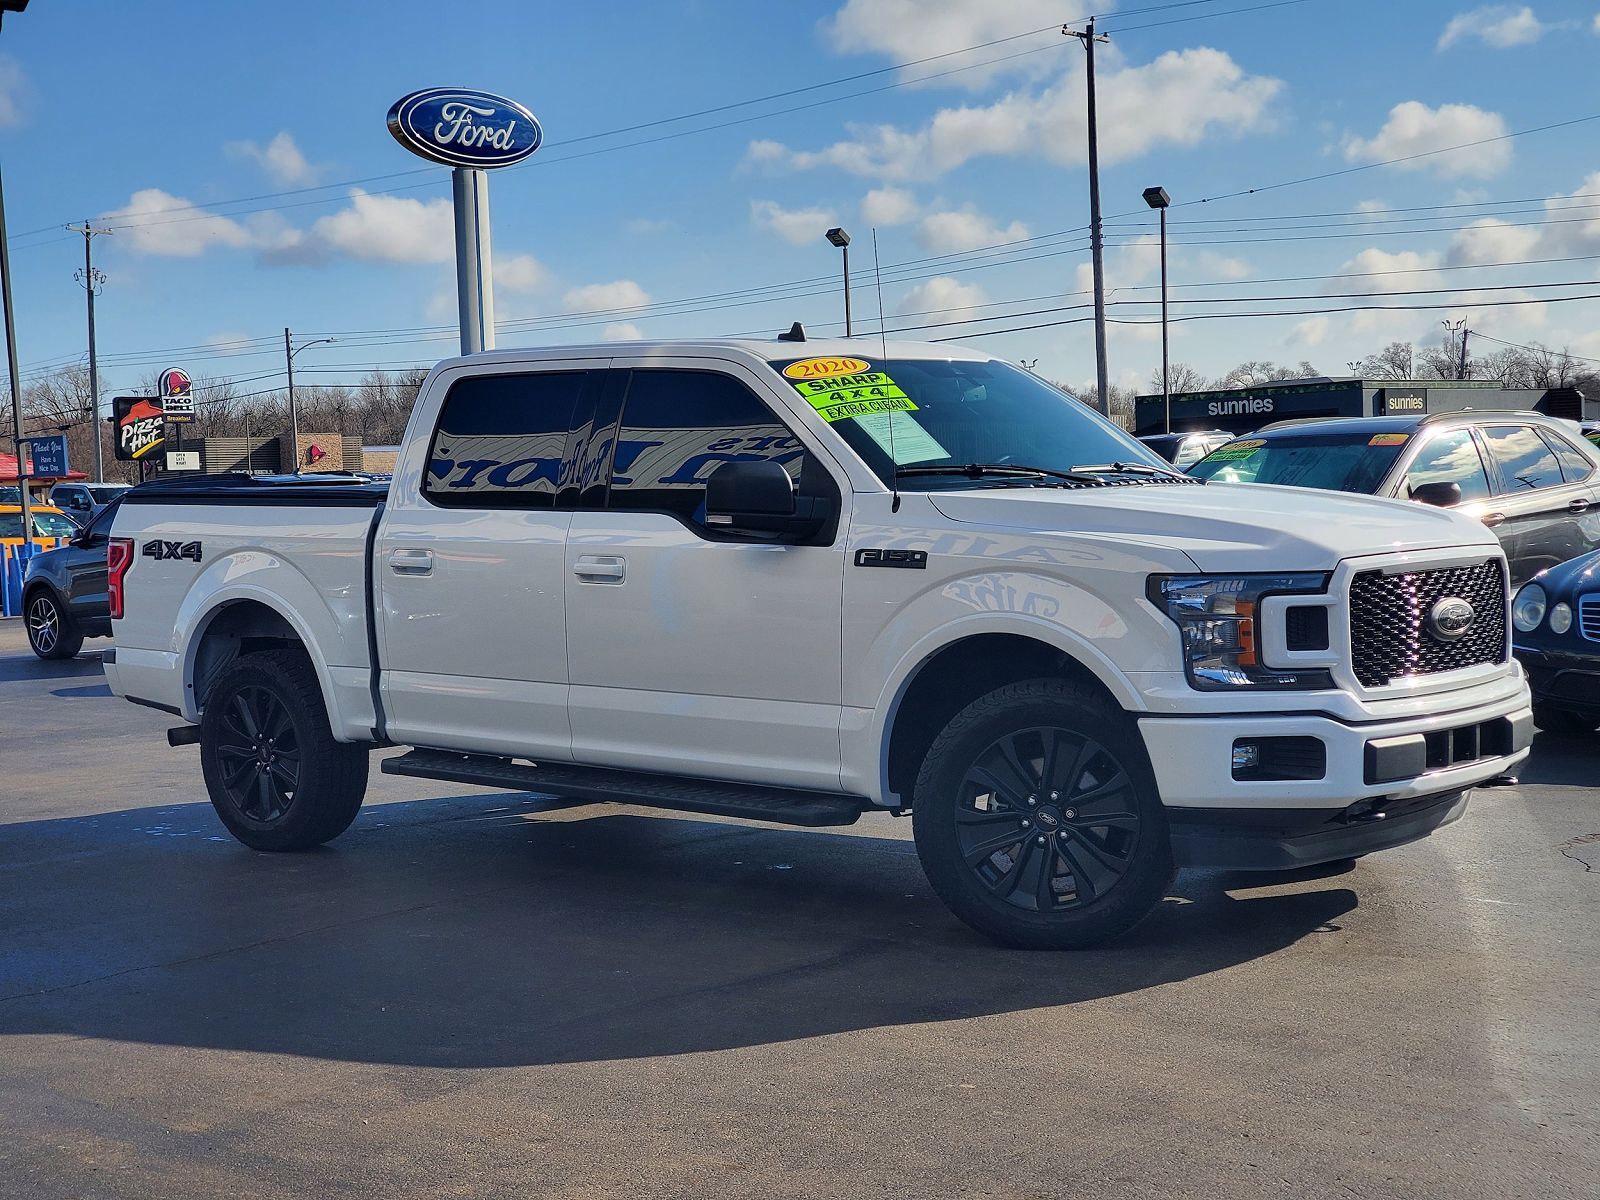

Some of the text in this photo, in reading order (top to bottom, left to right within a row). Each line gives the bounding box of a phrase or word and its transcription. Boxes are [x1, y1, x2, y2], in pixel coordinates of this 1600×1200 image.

[434, 102, 516, 150] Ford
[797, 359, 858, 377] 2020
[808, 373, 883, 391] SHARP
[826, 398, 910, 419] EXTRA CLEAN
[1208, 396, 1274, 416] sunnies
[1389, 394, 1424, 410] sunnies
[121, 416, 164, 448] Pizza
[130, 429, 161, 452] Hut
[33, 441, 62, 454] Thank You
